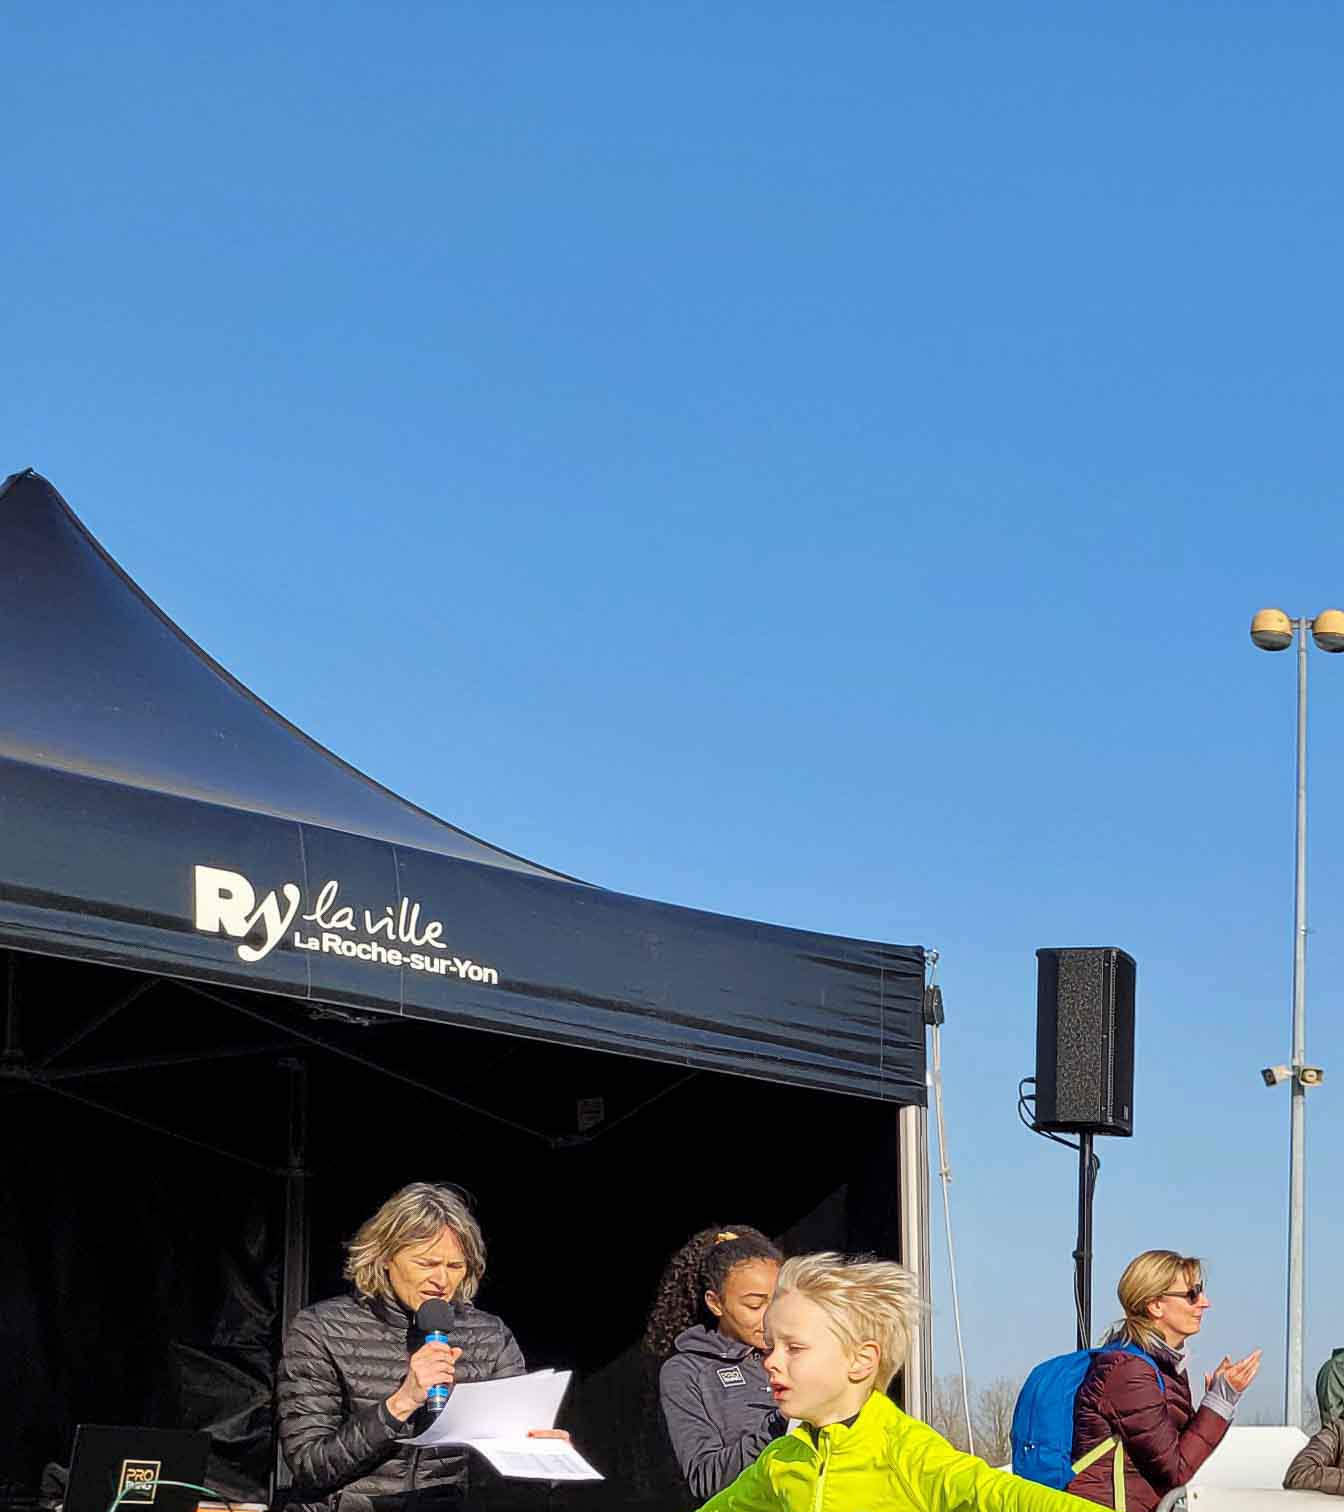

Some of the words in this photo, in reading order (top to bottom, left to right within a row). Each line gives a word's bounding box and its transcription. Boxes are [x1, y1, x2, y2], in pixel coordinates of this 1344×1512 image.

[302, 880, 356, 931] la
[363, 896, 447, 949] ville
[126, 1469, 154, 1481] PRO
